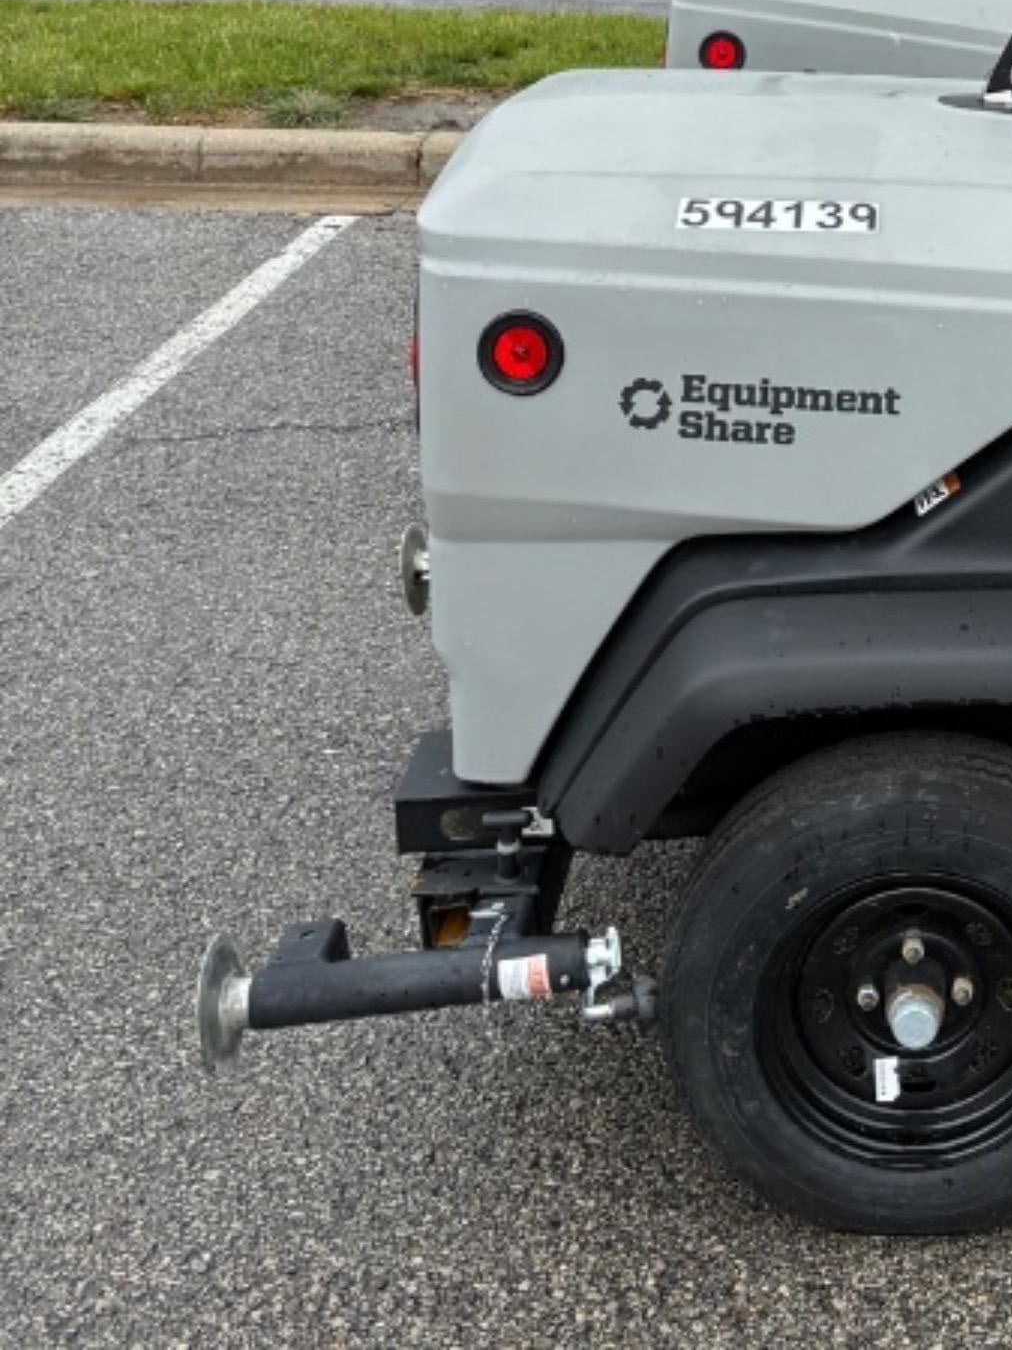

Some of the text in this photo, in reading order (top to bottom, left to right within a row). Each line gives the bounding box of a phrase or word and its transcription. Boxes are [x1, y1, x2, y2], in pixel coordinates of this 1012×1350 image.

[681, 199, 878, 231] 594139
[680, 375, 900, 415] Equipment
[678, 412, 795, 445] Share
